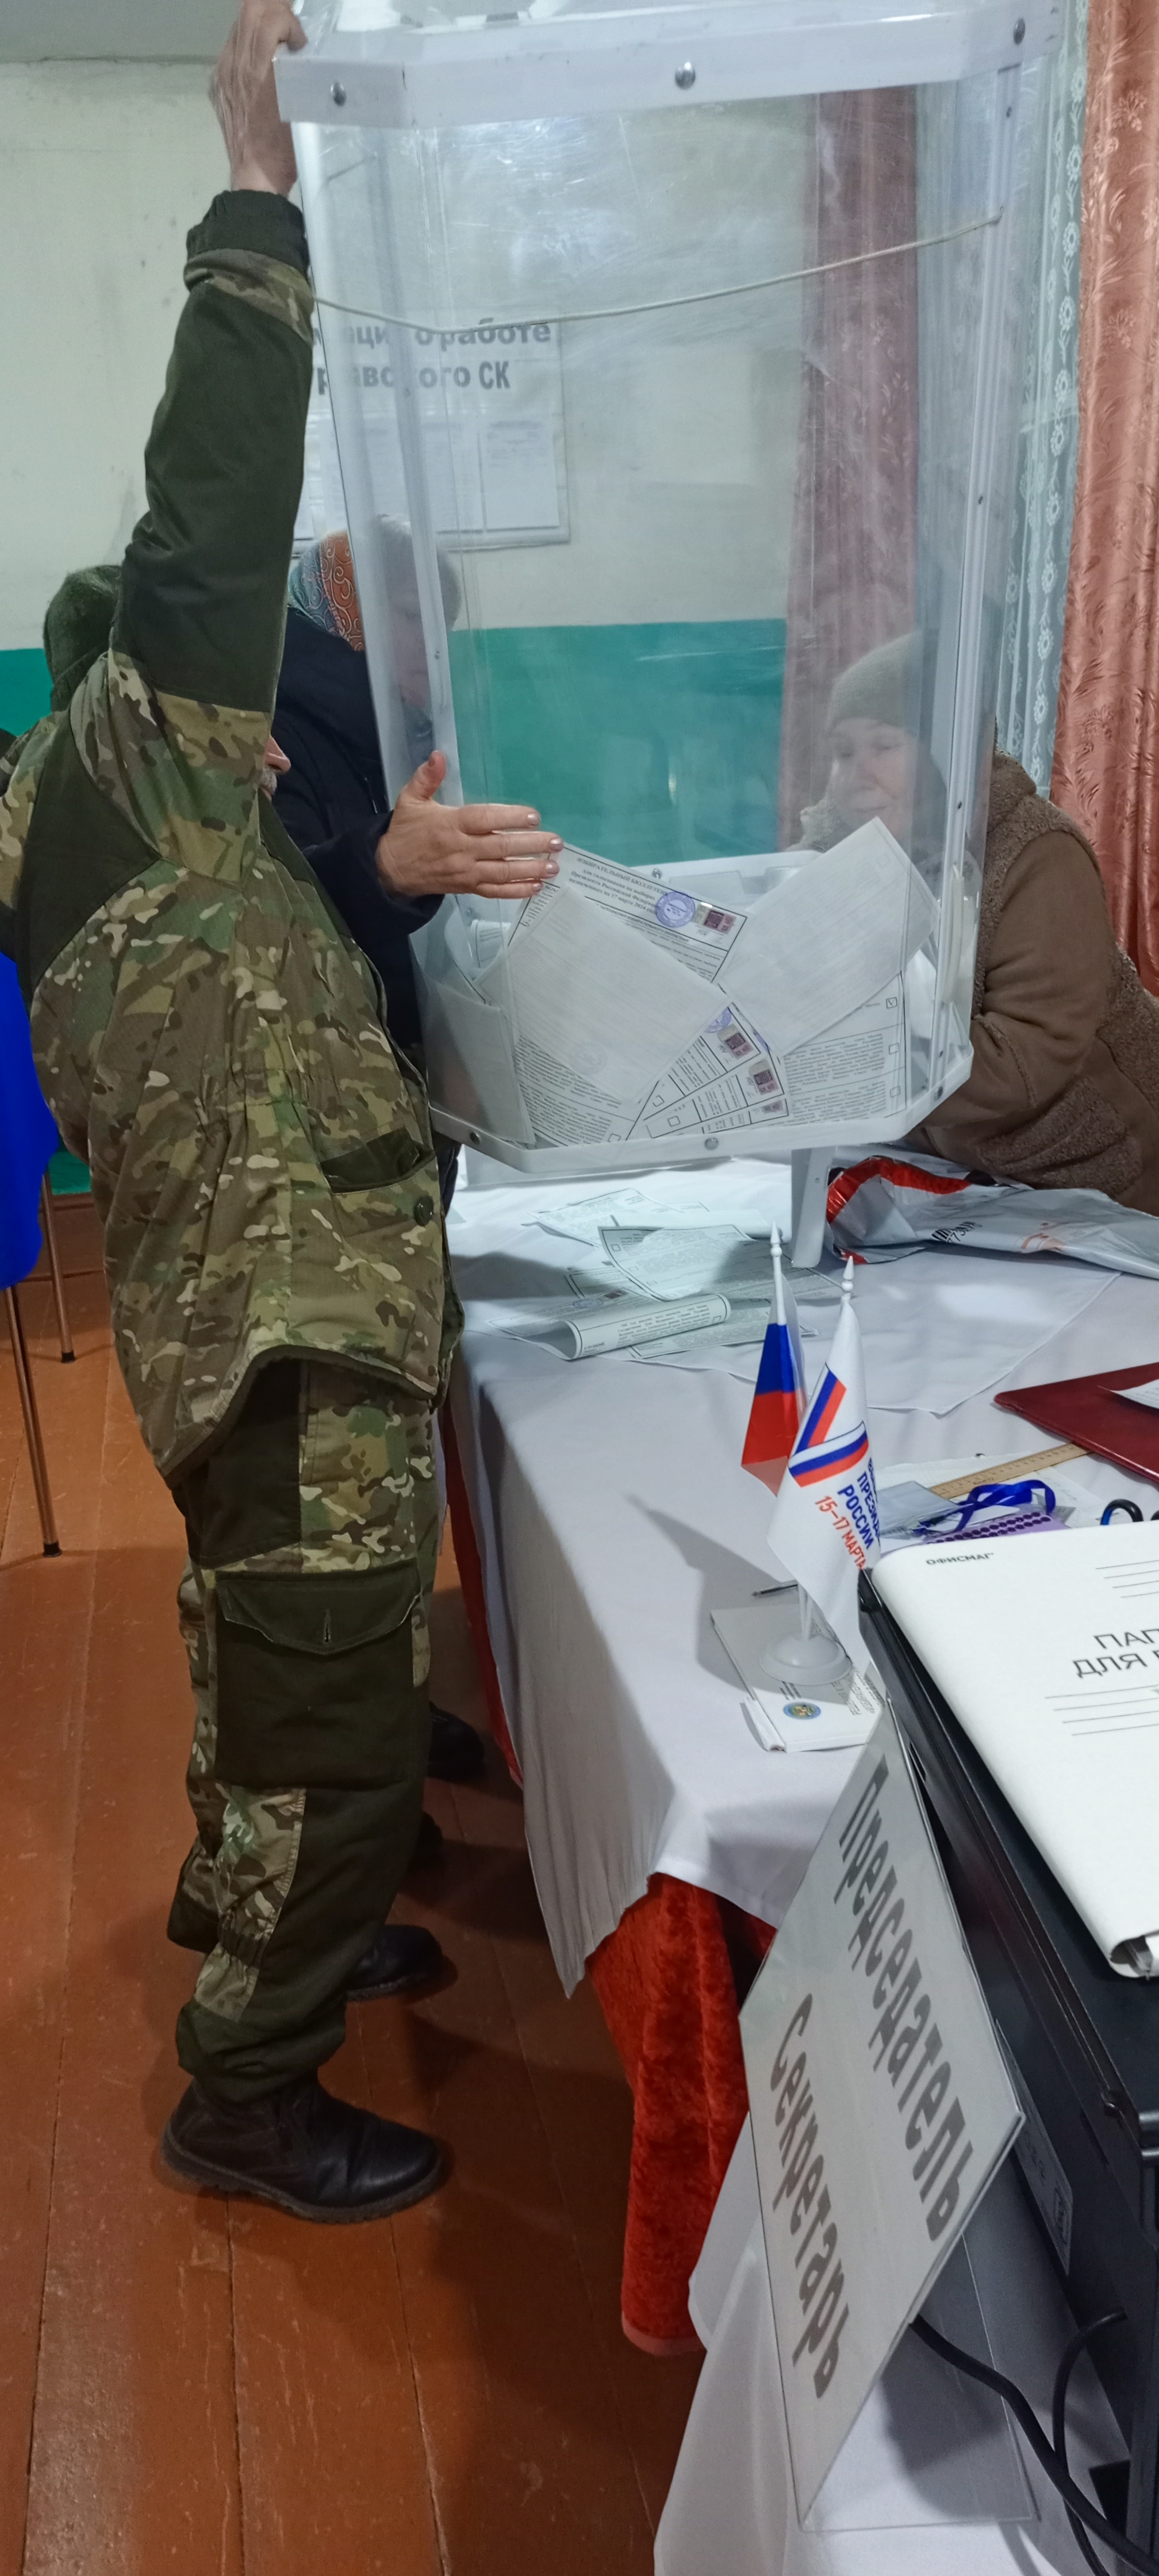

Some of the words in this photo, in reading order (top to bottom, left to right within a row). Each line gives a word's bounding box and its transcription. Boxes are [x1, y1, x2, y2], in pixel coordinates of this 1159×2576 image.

[440, 318, 552, 351] работе
[479, 361, 511, 390] СК
[837, 1484, 874, 1550] РОССИИ
[842, 1529, 867, 1570] МАРТА
[926, 1552, 993, 1565] ОФИСМАГ
[1072, 1653, 1148, 1678] ДЛЯ
[833, 1753, 974, 2242] Председатель
[770, 1993, 849, 2399] Секретарь
